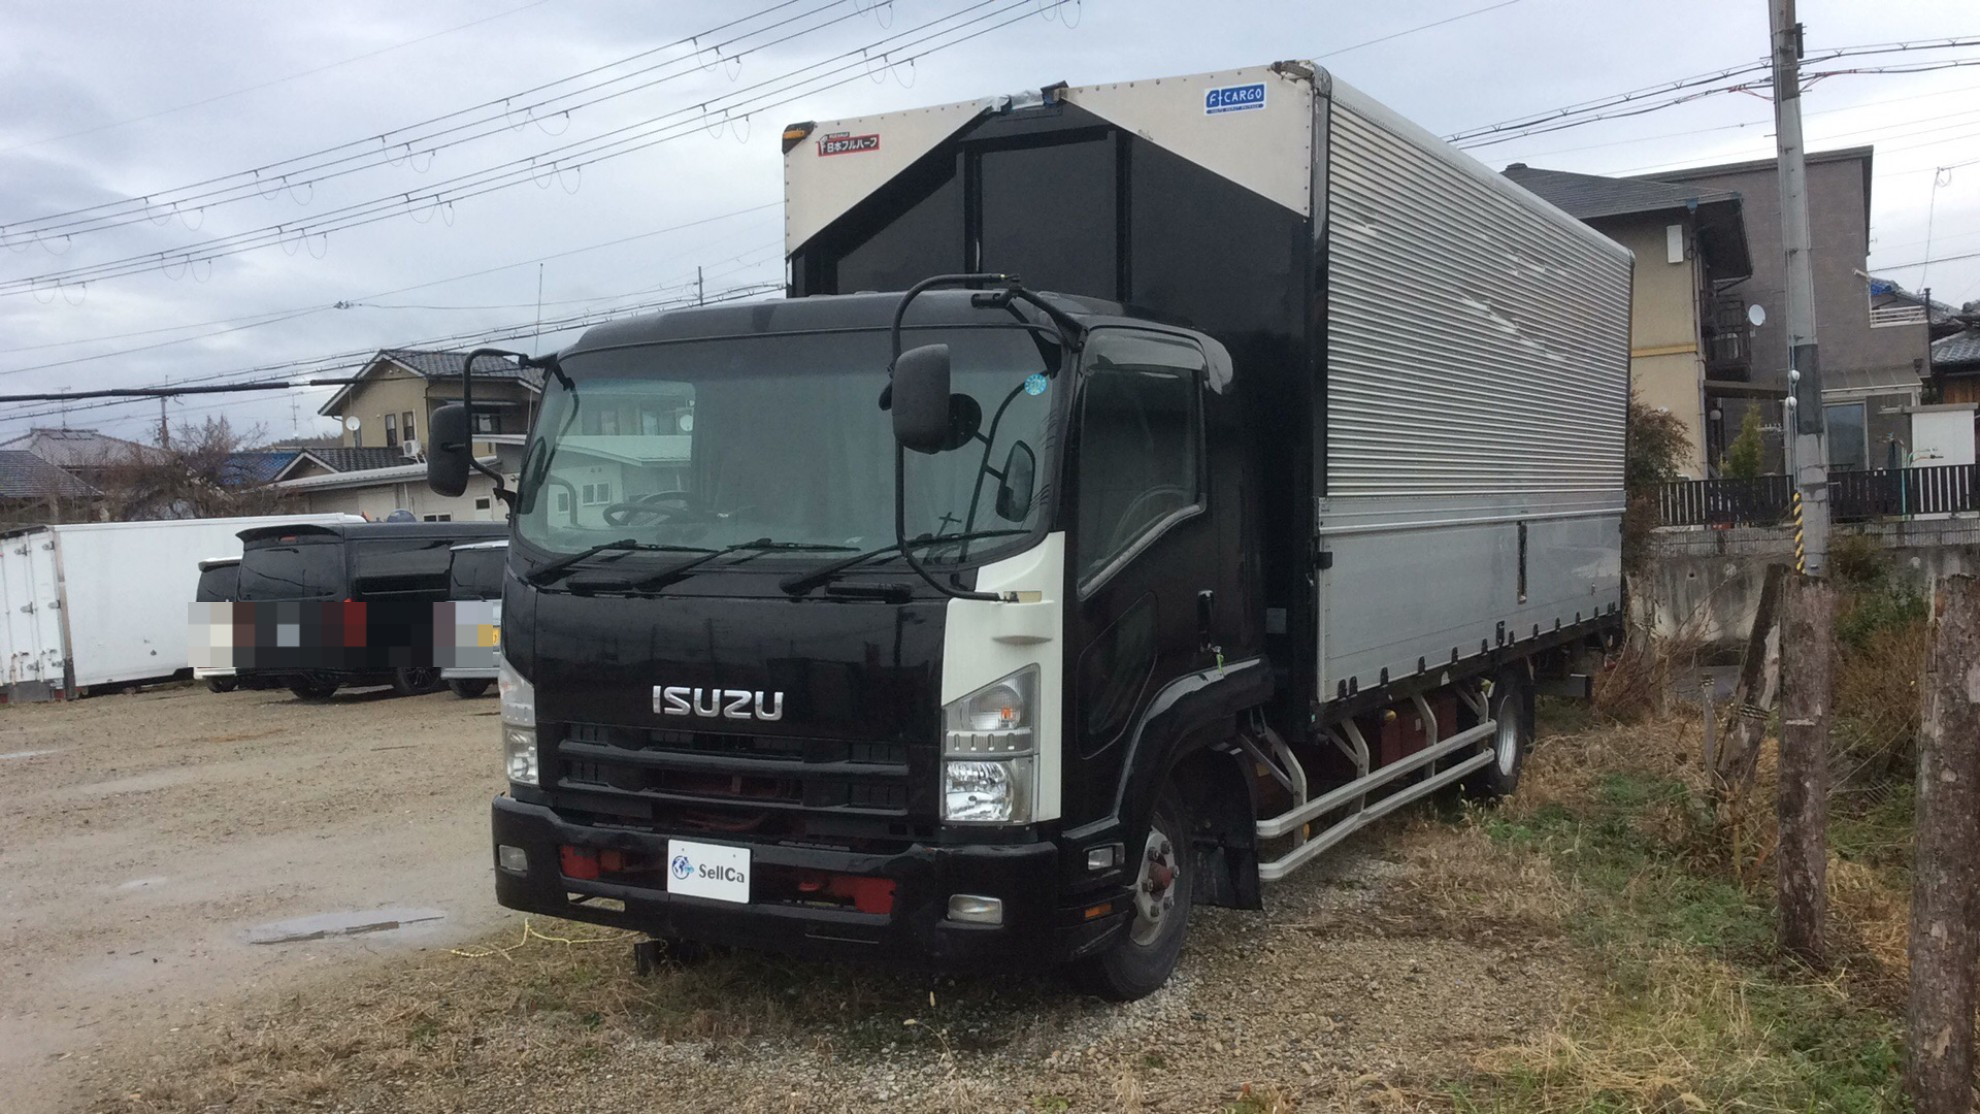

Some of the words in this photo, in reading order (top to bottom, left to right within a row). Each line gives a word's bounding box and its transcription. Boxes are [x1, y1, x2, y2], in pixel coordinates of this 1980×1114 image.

[827, 137, 877, 153] 日本フルハーフ
[652, 685, 784, 721] ISUZU
[698, 863, 745, 883] SellCa
